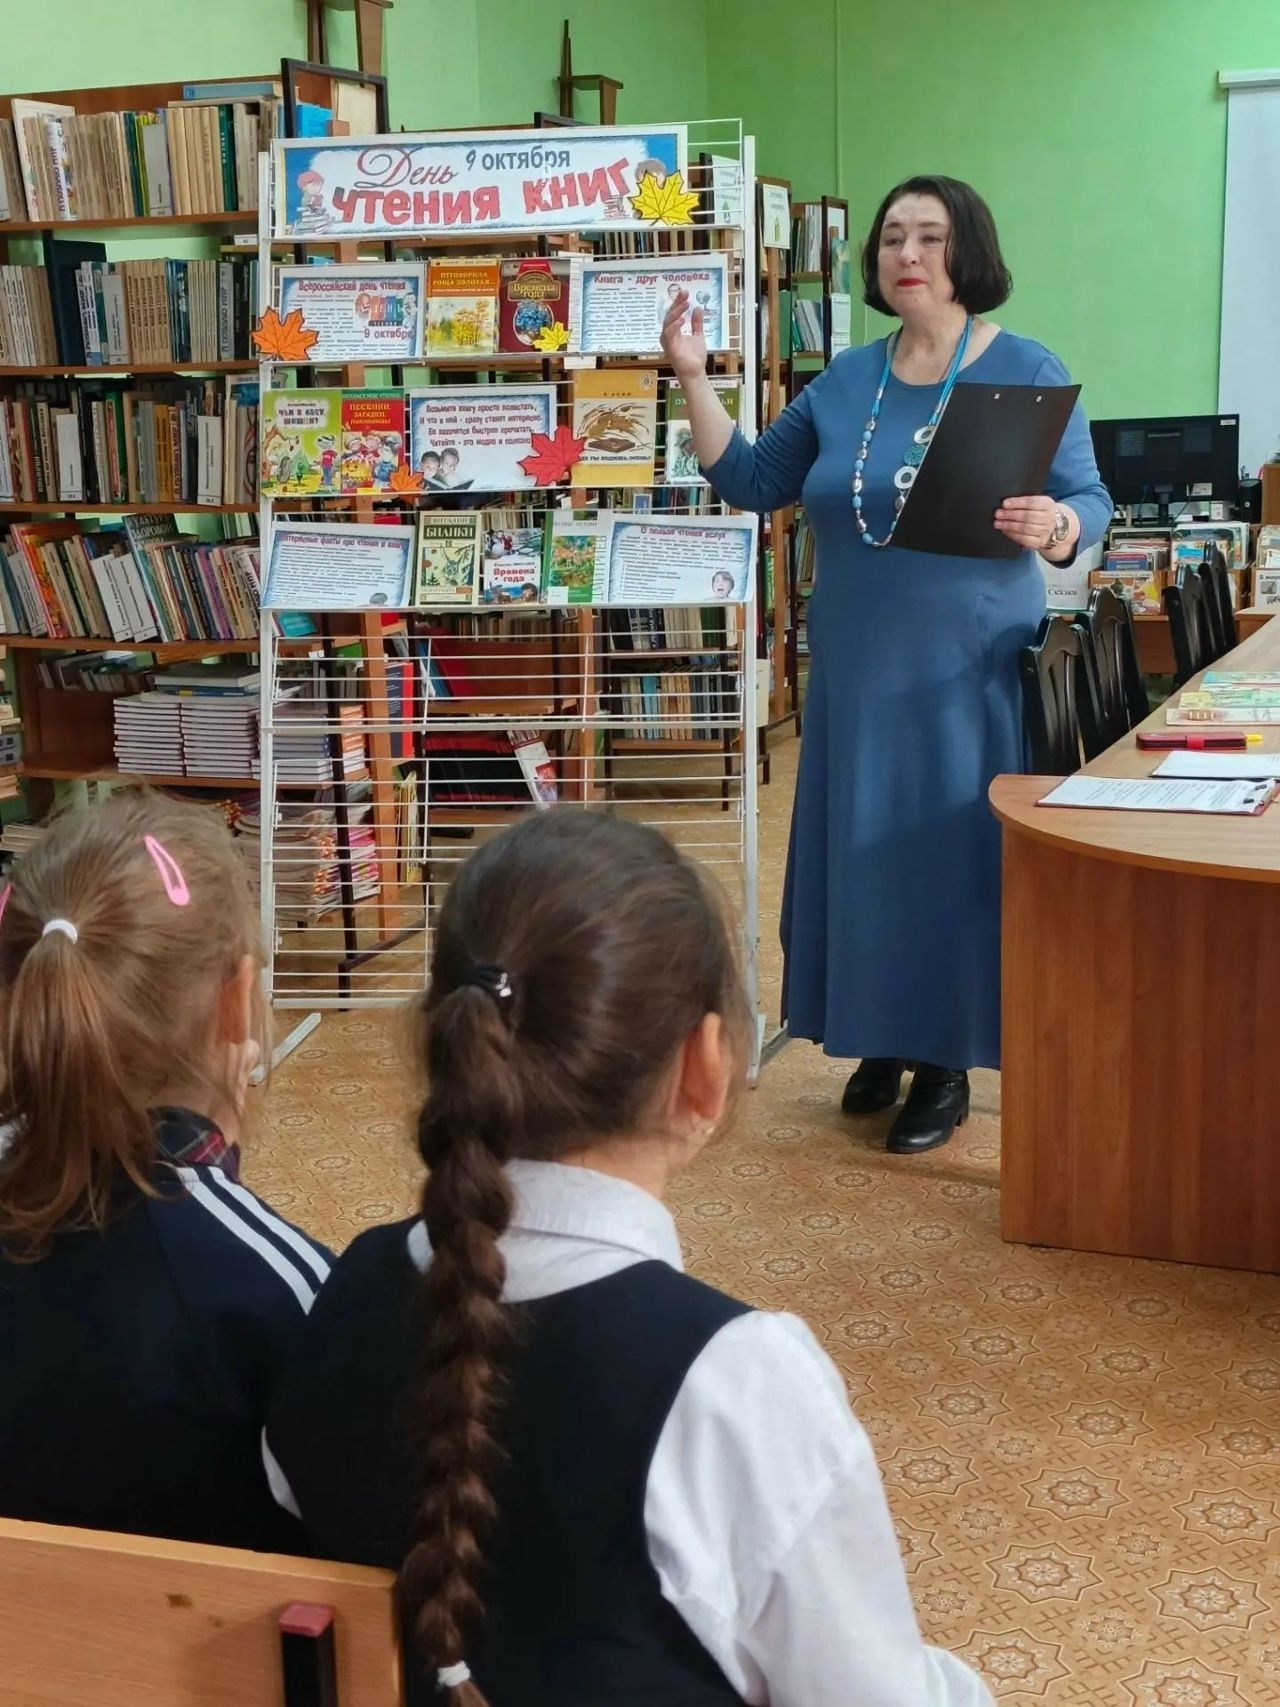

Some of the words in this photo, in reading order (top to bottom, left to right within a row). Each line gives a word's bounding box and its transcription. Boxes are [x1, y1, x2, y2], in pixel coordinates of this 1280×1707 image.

[466, 150, 476, 171] 9
[482, 145, 570, 171] октября
[354, 144, 459, 188] День
[594, 273, 624, 284] Книга
[635, 274, 658, 285] друг
[662, 272, 710, 283] человека
[426, 527, 473, 537] БИАНКИ
[493, 568, 535, 577] Времена
